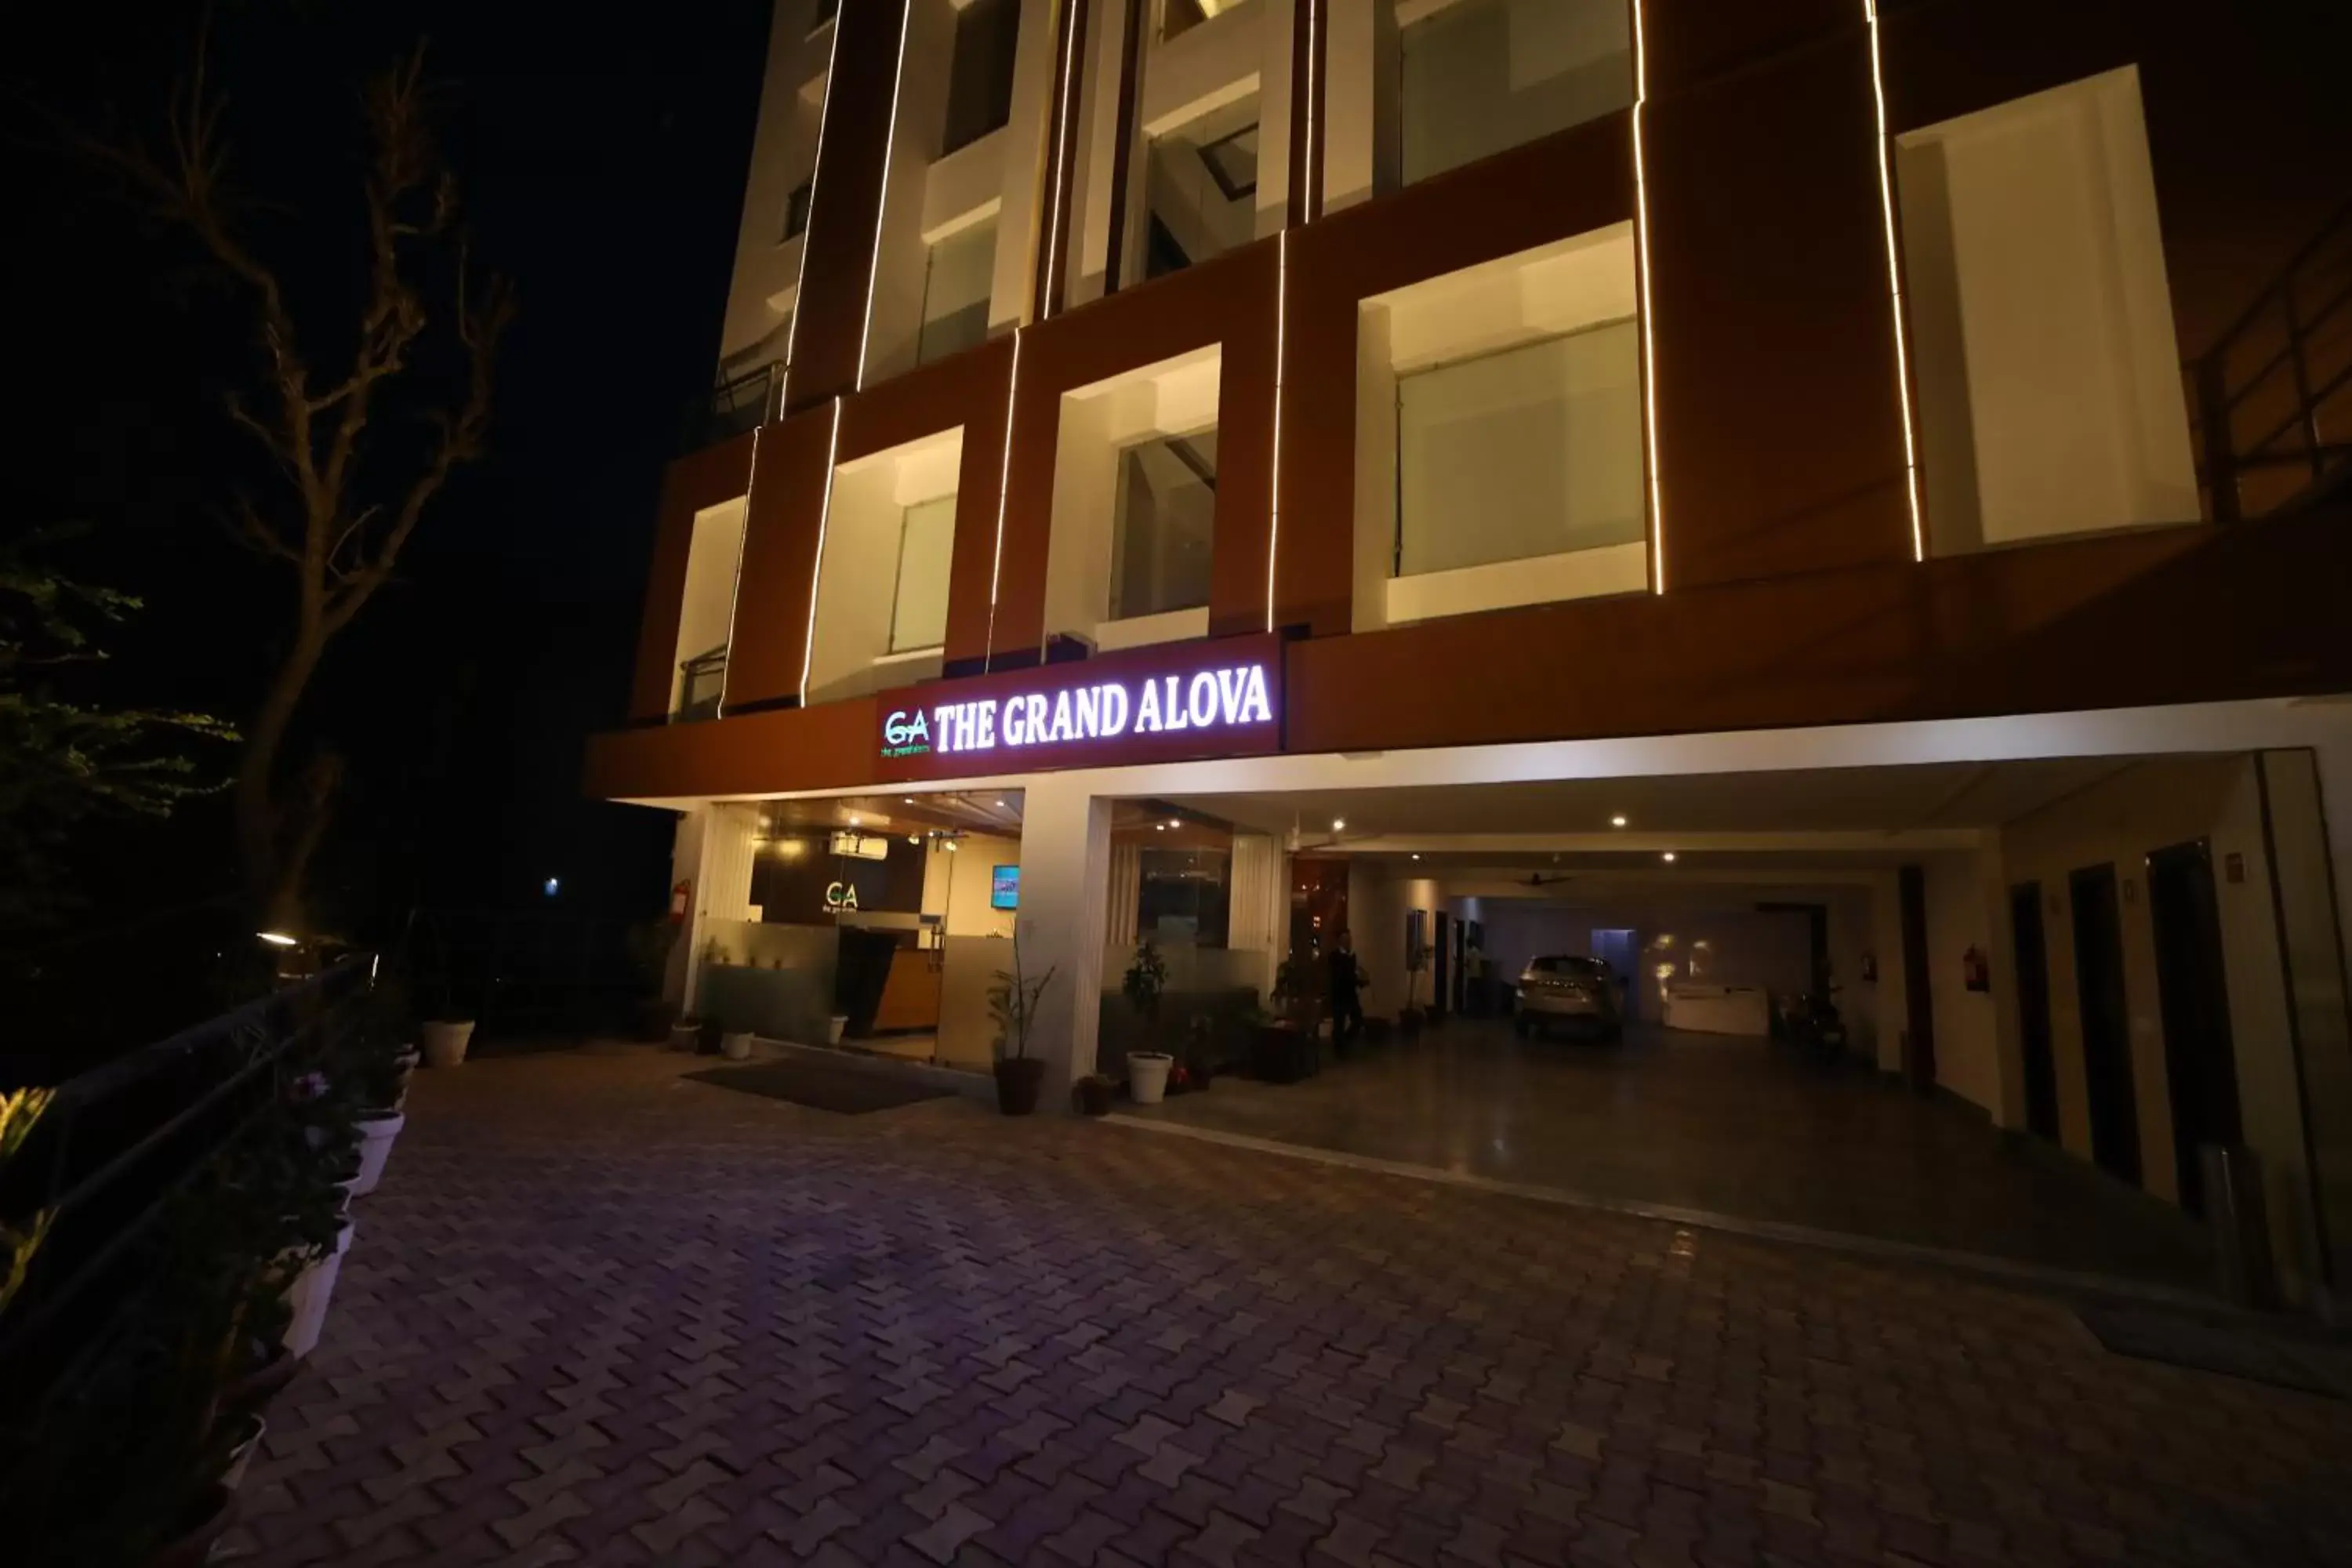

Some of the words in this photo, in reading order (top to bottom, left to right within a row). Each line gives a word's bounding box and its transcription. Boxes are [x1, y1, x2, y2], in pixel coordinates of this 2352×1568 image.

[935, 700, 996, 753] THE
[1003, 684, 1129, 746] GRAND
[1134, 665, 1272, 732] ALOVA
